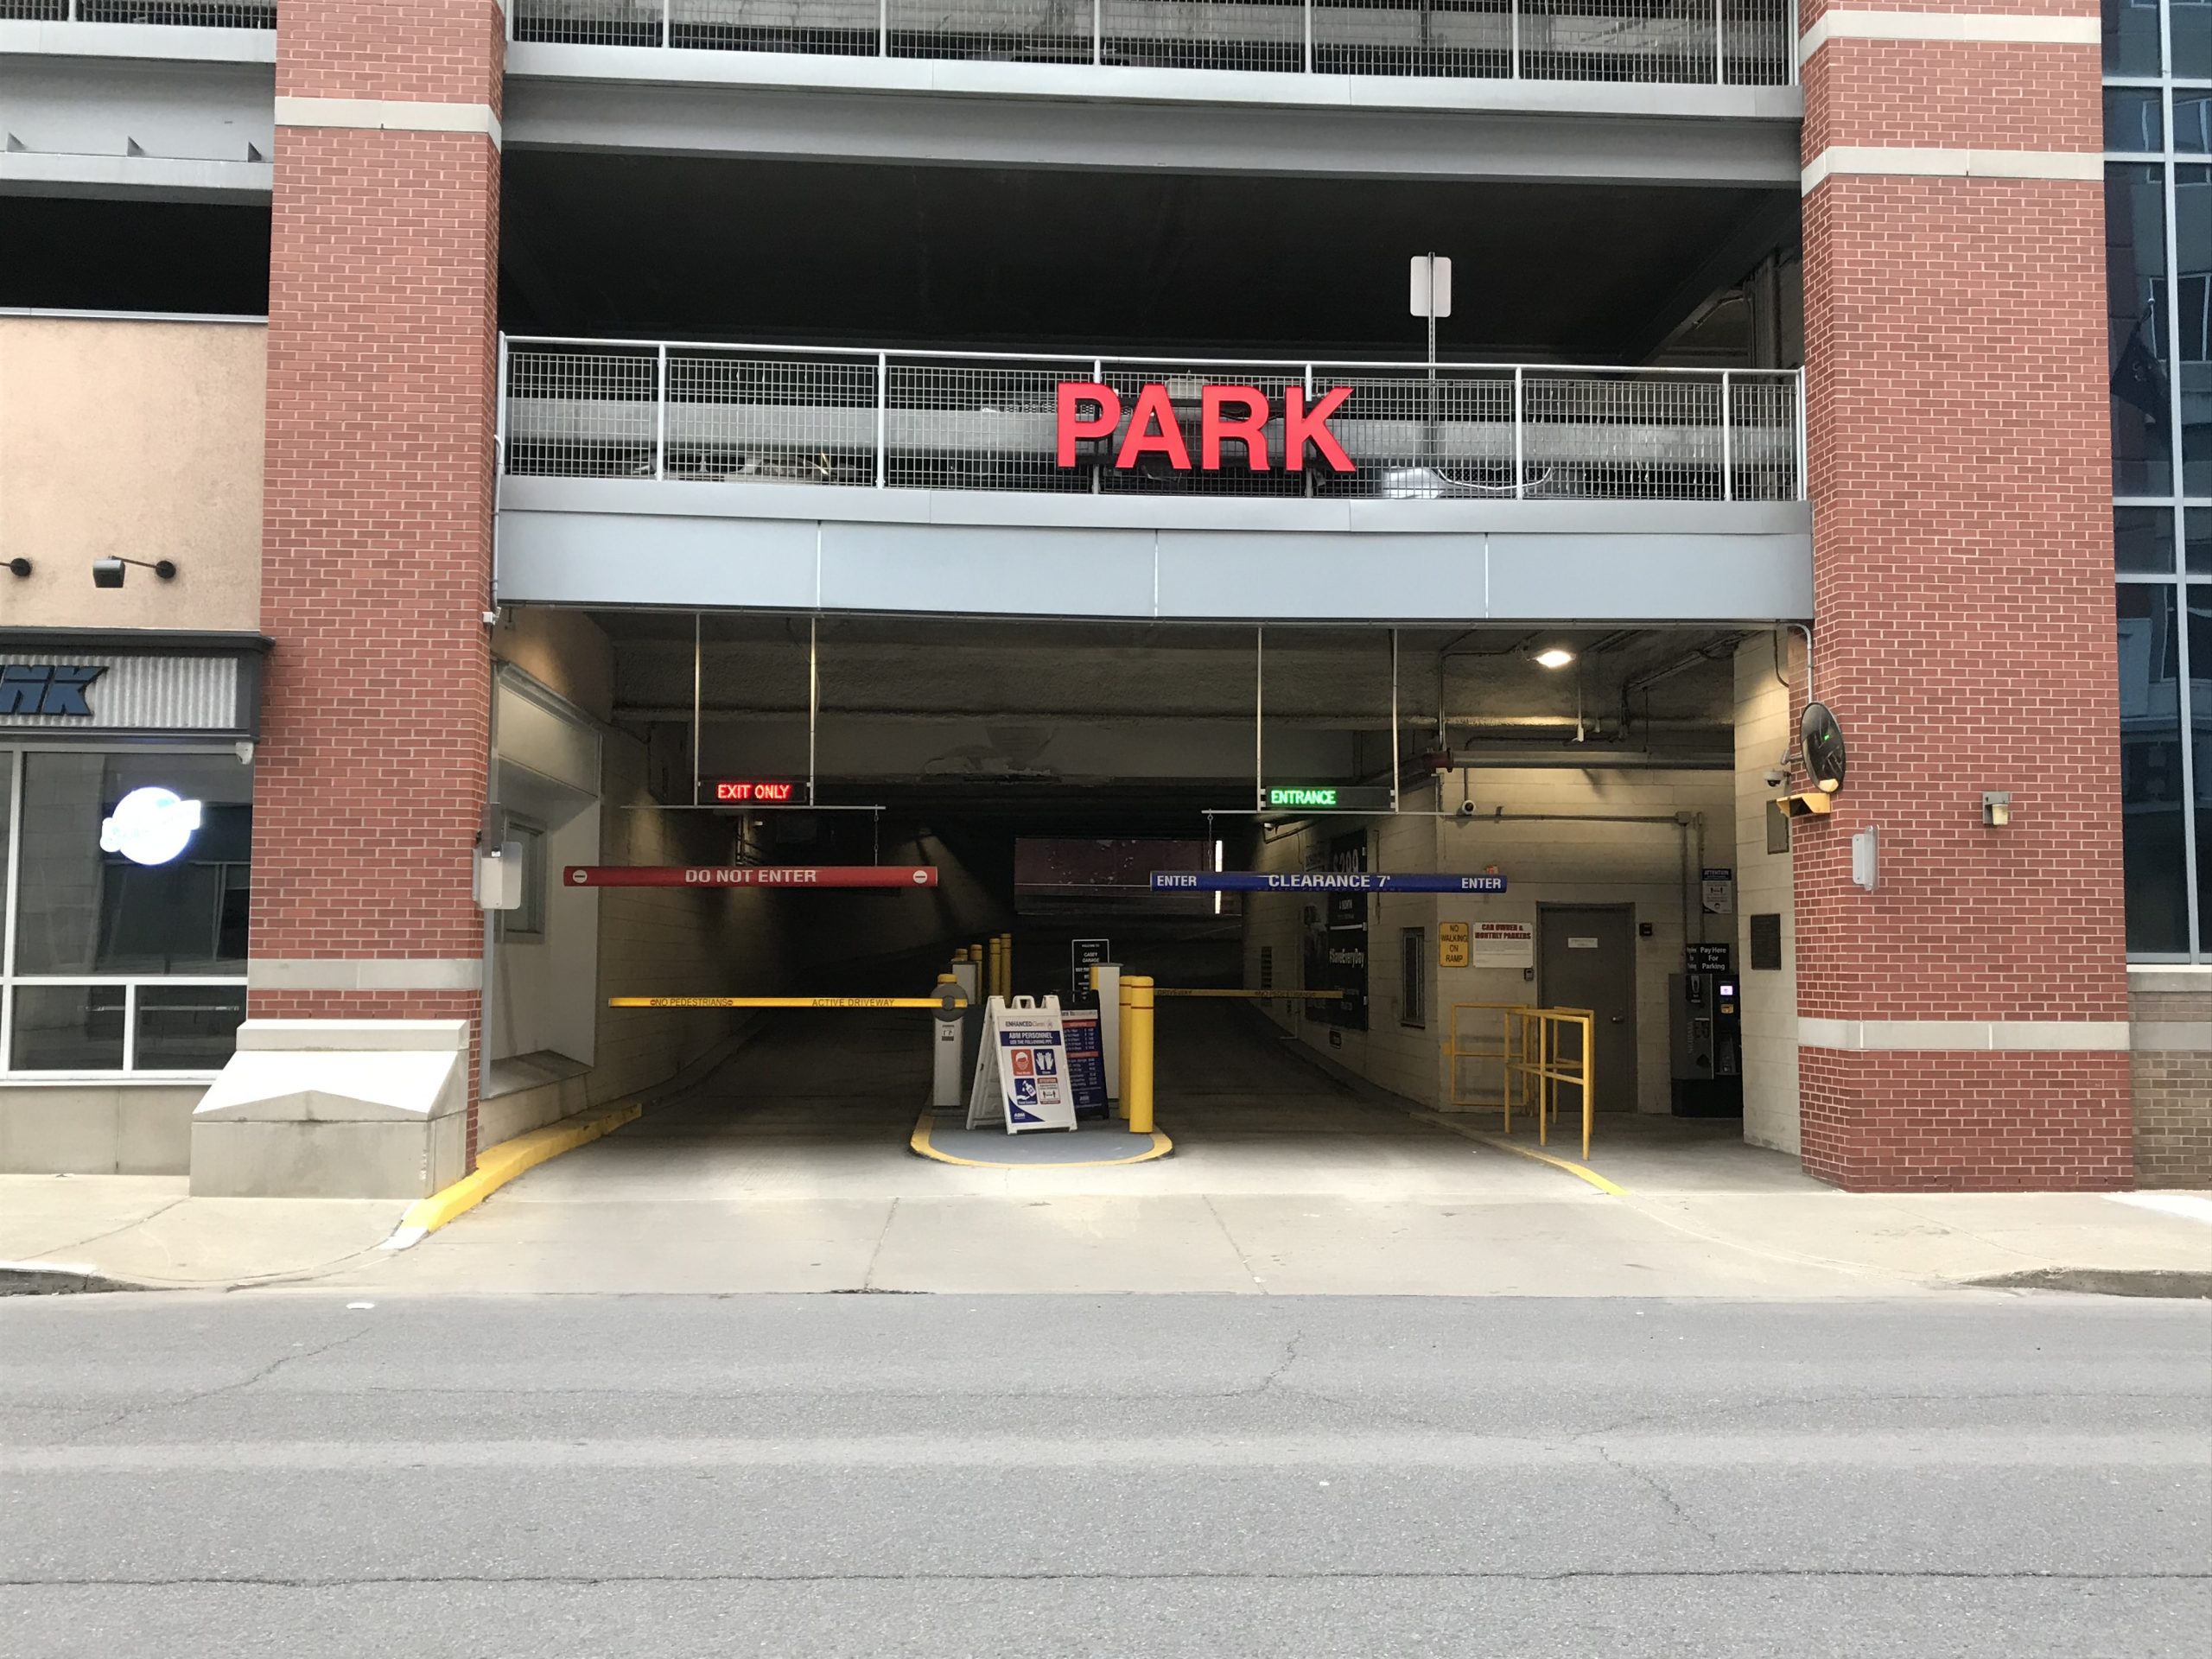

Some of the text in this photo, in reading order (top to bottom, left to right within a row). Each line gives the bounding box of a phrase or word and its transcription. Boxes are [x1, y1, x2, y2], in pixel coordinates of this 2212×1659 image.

[1057, 382, 1357, 473] PARK
[717, 784, 791, 800] EXIT ONLY
[1271, 790, 1336, 804] ENTRANCE
[685, 869, 817, 883] DO NOT ENTER
[1156, 875, 1198, 887] ENTER
[1268, 874, 1391, 888] CLEARANCE 7'
[1461, 877, 1502, 890] ENTER
[1446, 954, 1464, 963] RAMP
[1701, 963, 1726, 971] Parking
[655, 997, 728, 1007] NO PEDESTRIANS
[811, 998, 895, 1007] ACTIVE DRIVEWAY
